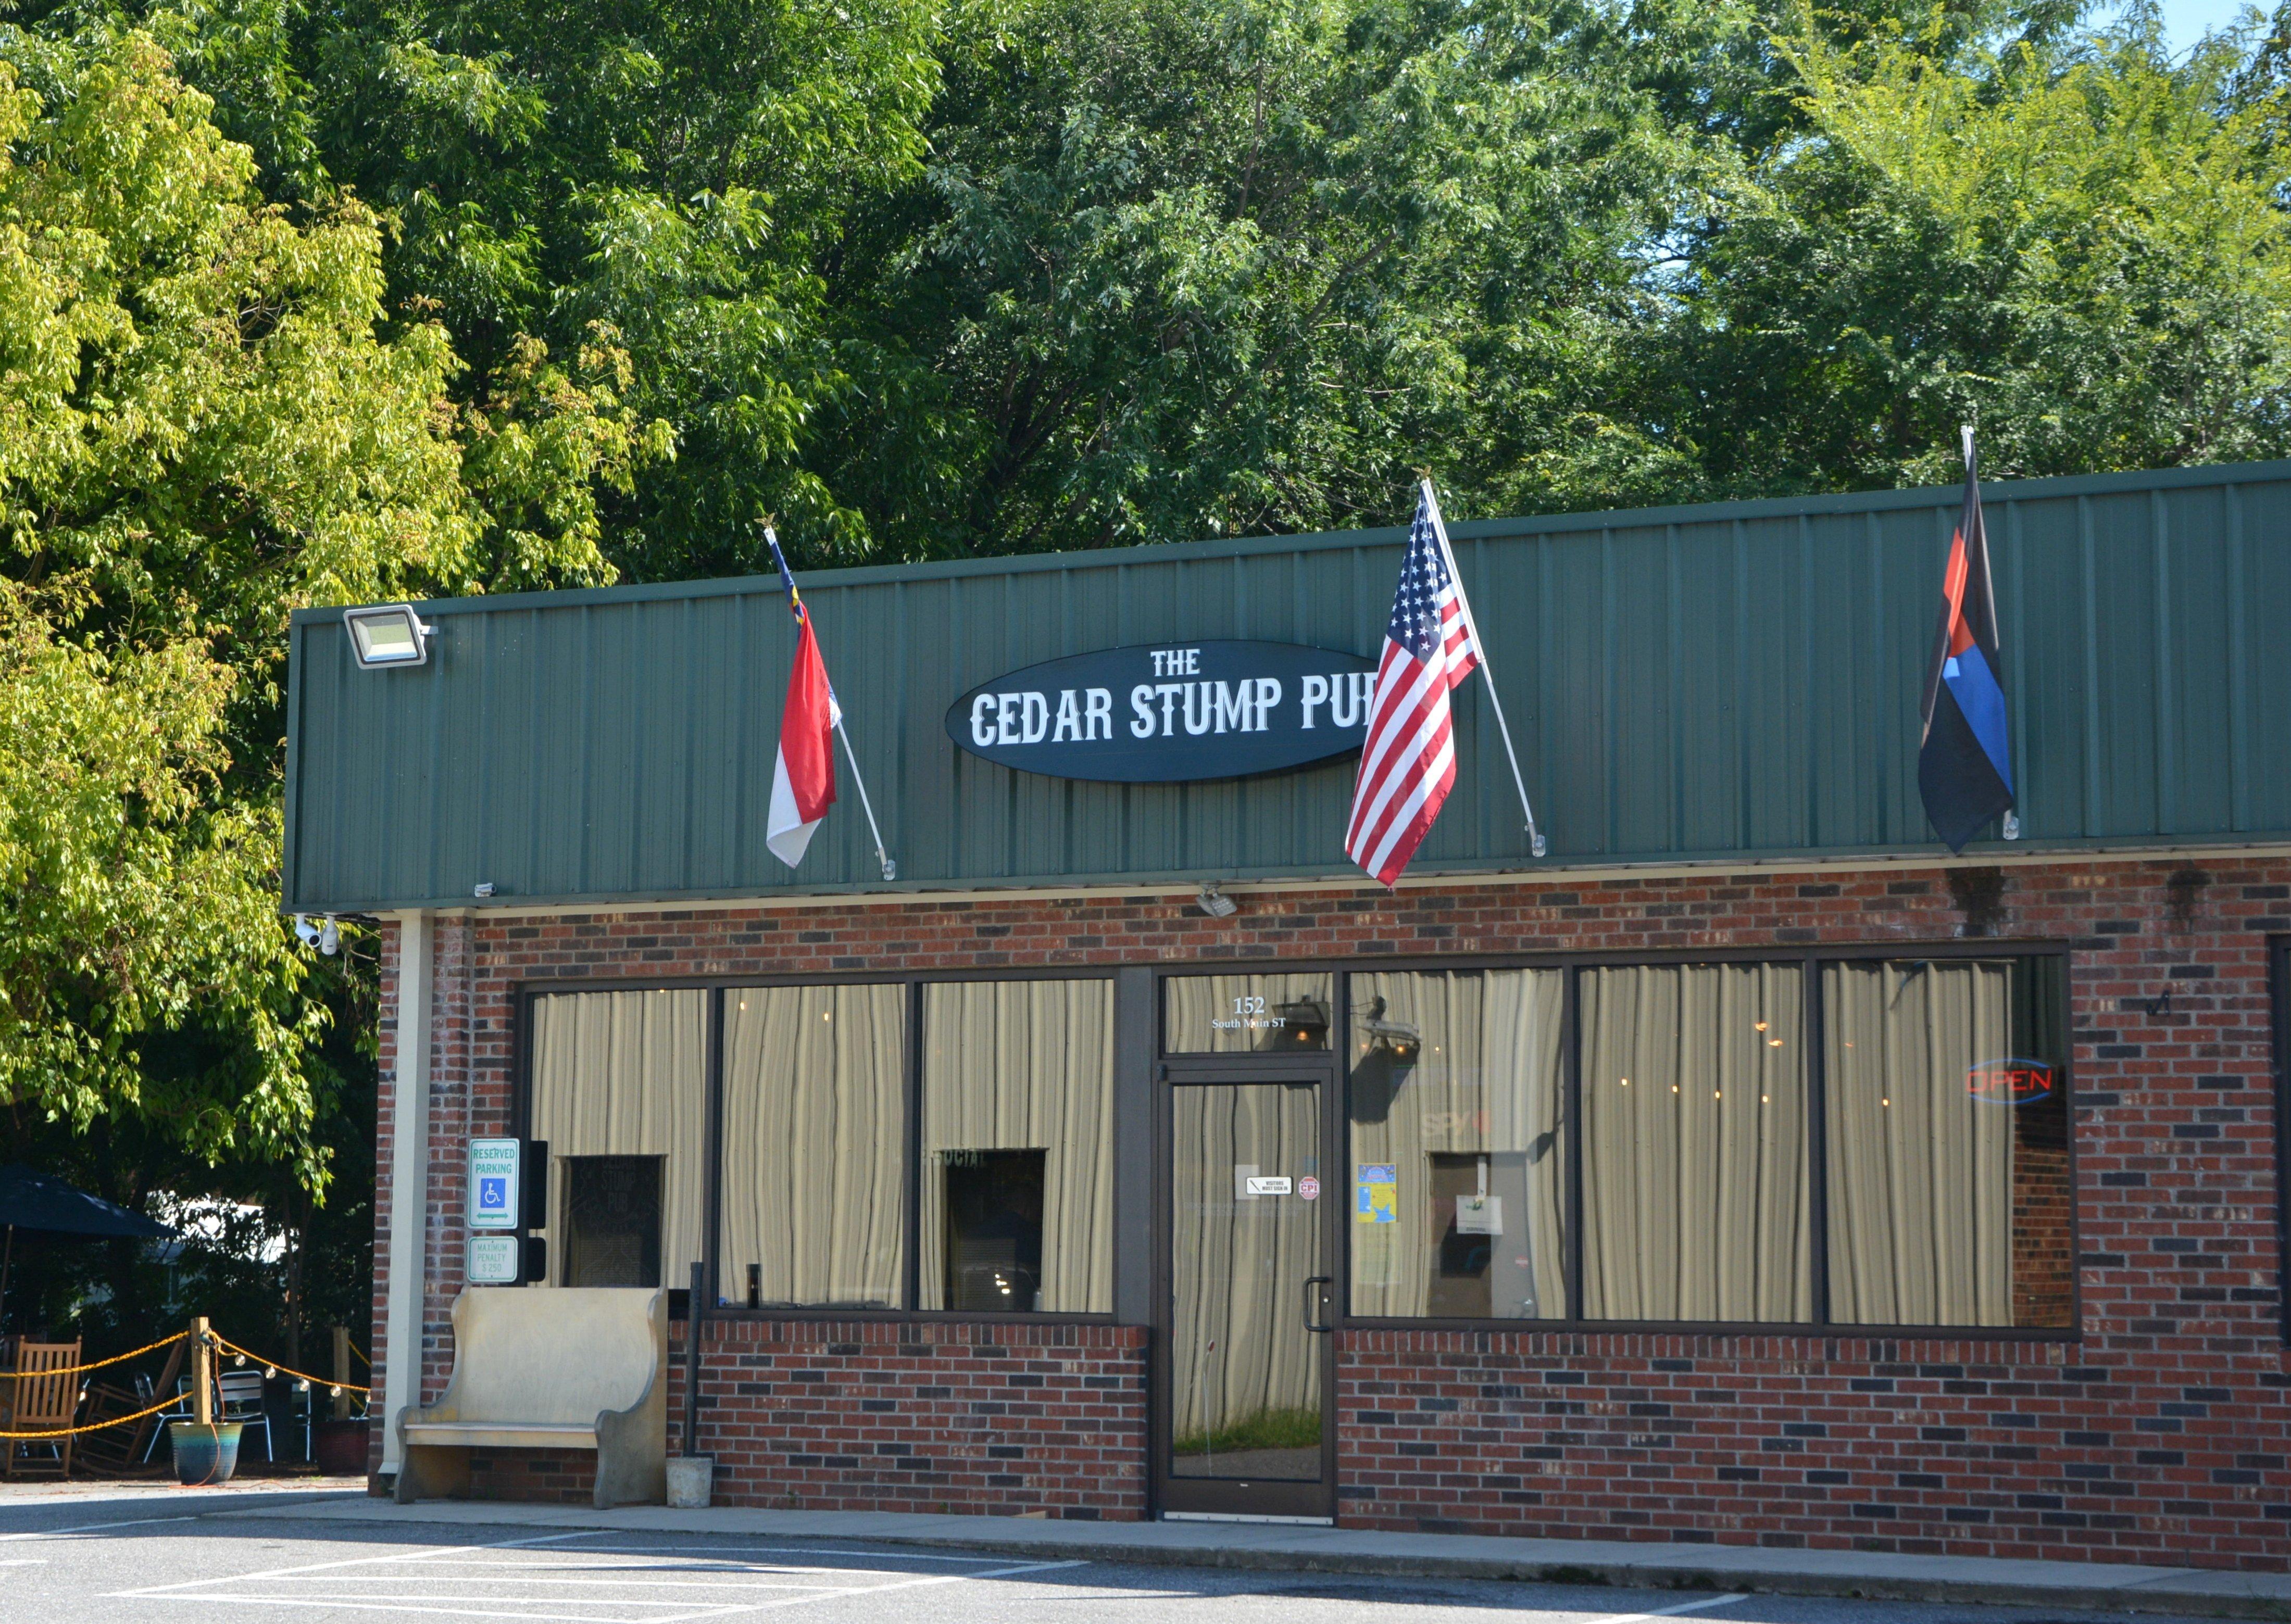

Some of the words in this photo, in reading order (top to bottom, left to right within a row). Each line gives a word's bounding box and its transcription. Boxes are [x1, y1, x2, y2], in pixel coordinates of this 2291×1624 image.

[1150, 649, 1200, 676] THE
[970, 688, 1112, 747] CEDAR
[1130, 677, 1282, 738] STUMP
[1233, 997, 1265, 1014] 152
[1212, 1019, 1241, 1028] South
[1272, 1017, 1286, 1027] ST
[1966, 1069, 2051, 1092] OPEN
[473, 1149, 515, 1159] RESERVED
[475, 1163, 511, 1174] PARKING
[477, 1243, 507, 1252] MAXIMUM
[477, 1253, 506, 1262] PENALTY
